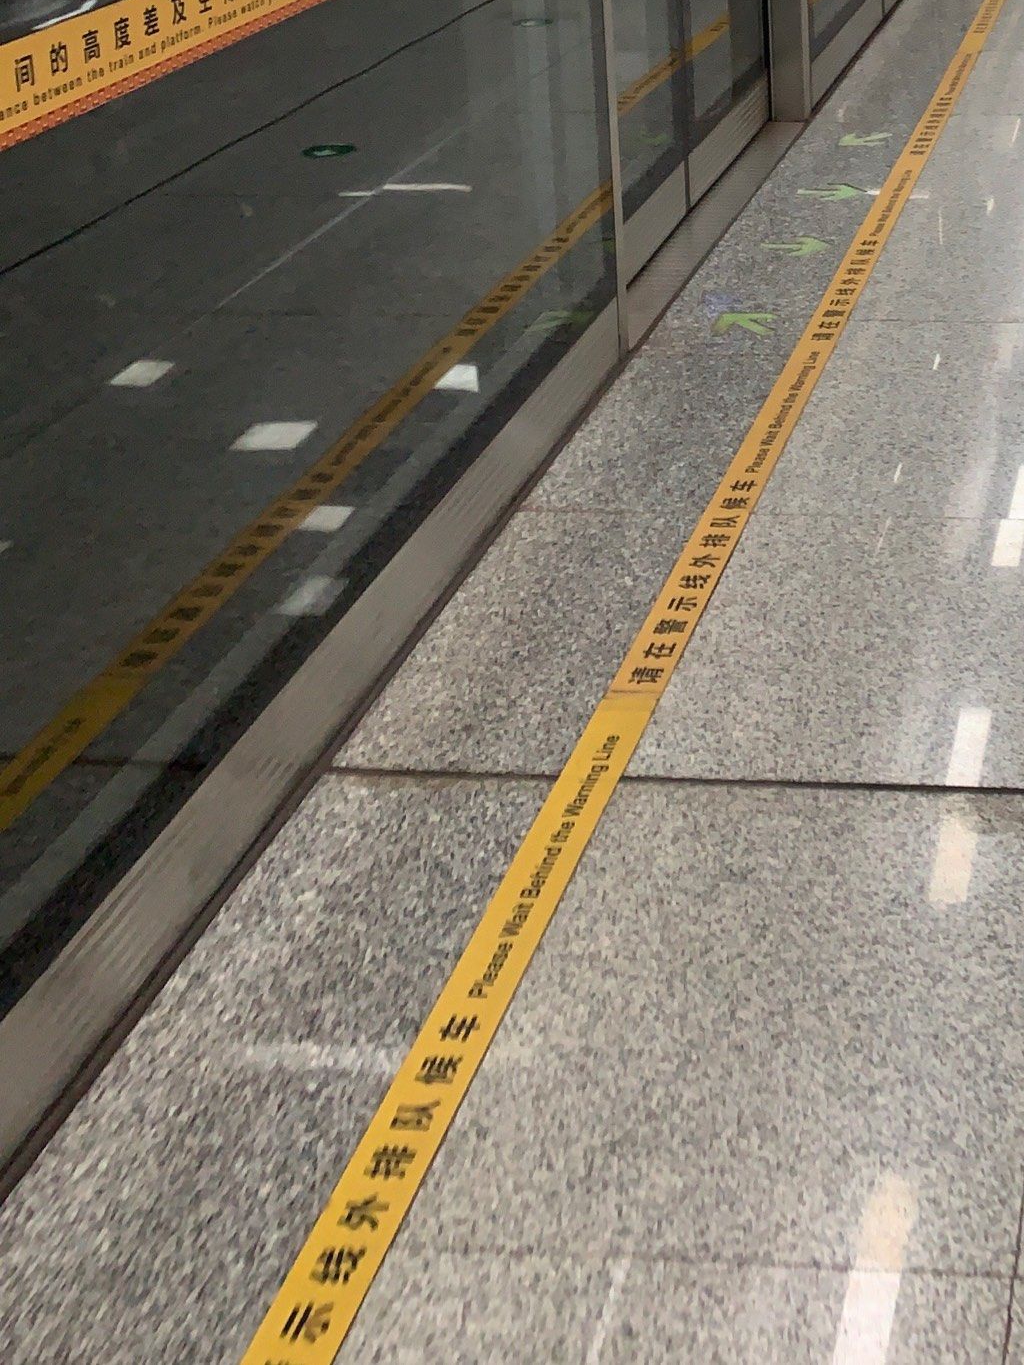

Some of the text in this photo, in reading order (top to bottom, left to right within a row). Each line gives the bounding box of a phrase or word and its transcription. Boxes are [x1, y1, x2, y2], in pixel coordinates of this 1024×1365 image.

[33, 76, 83, 106] between
[87, 66, 105, 83] the
[109, 53, 134, 73] train
[138, 42, 157, 60] and
[208, 8, 237, 28] Please
[745, 350, 820, 474] Please Wait Behind the Warning Line
[628, 479, 759, 685] 请在警示线外排队候车
[467, 733, 620, 999] Please Wait Behind the Warning Line
[264, 1013, 480, 1365] 示线外排队候车
